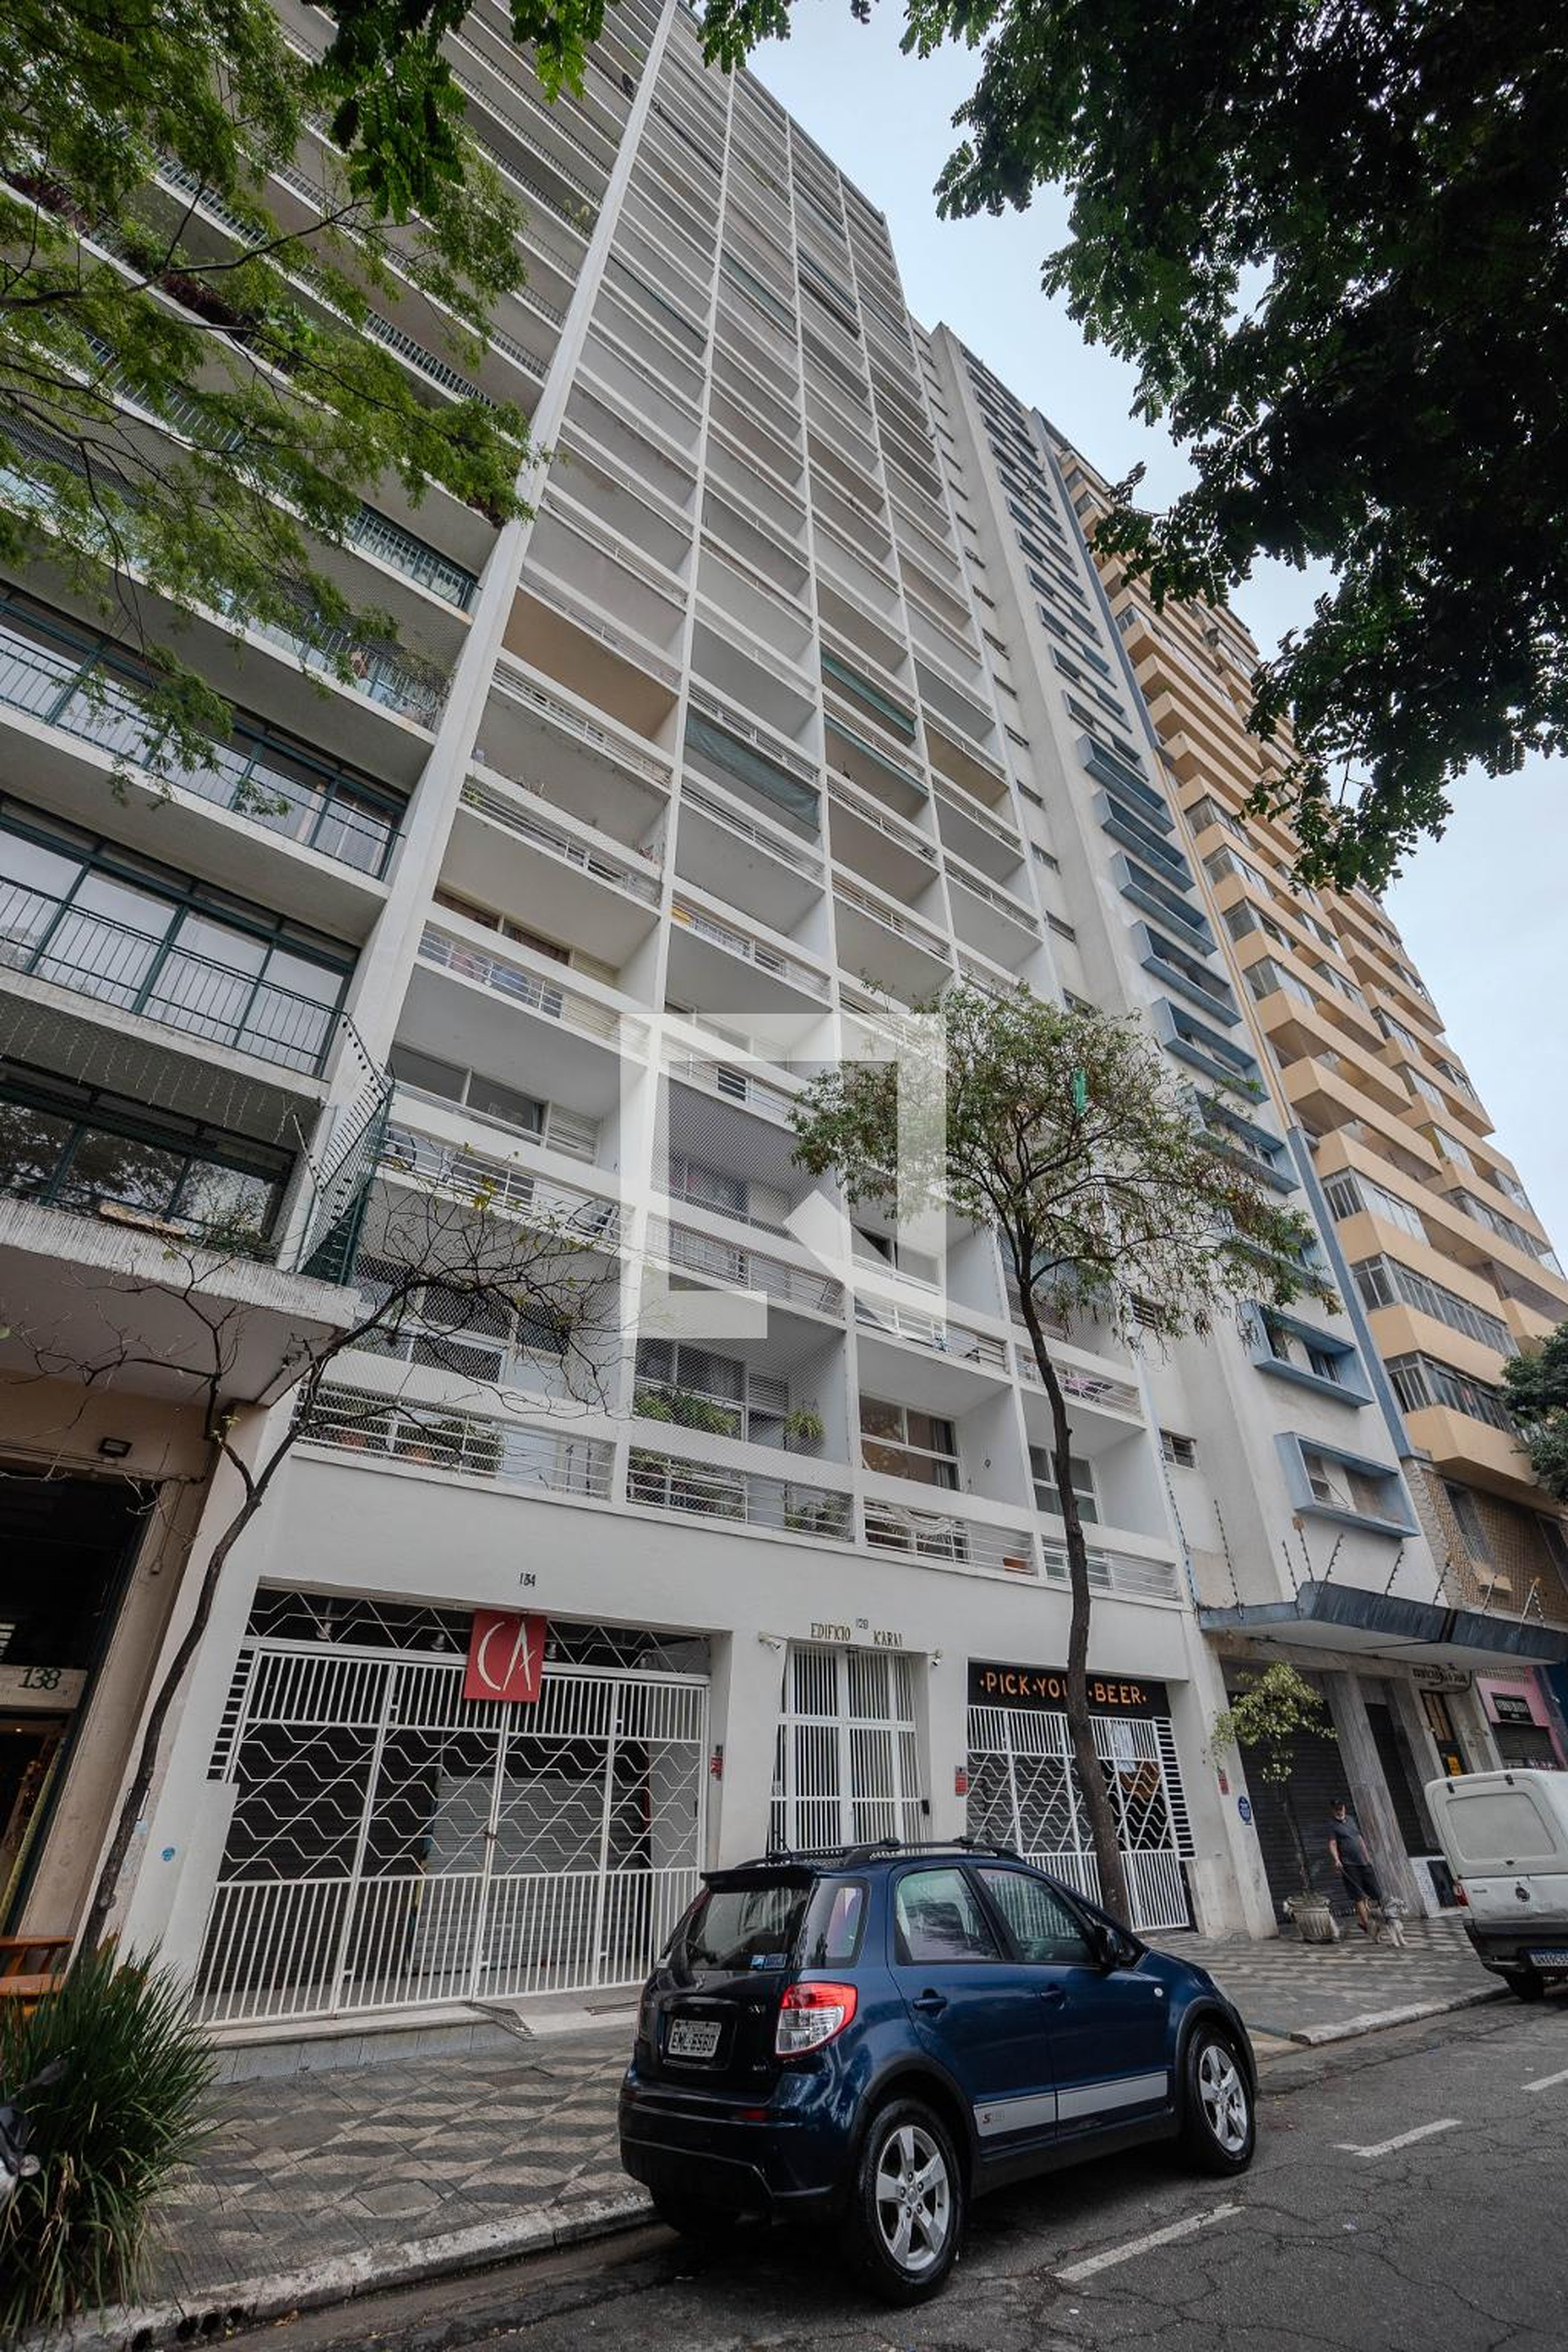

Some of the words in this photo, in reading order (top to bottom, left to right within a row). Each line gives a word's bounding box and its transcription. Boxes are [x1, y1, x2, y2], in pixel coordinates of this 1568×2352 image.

[519, 1572, 536, 1587] 134
[18, 1666, 62, 1690] 138
[986, 1672, 1030, 1696] PICK
[1094, 1682, 1142, 1704] BEER
